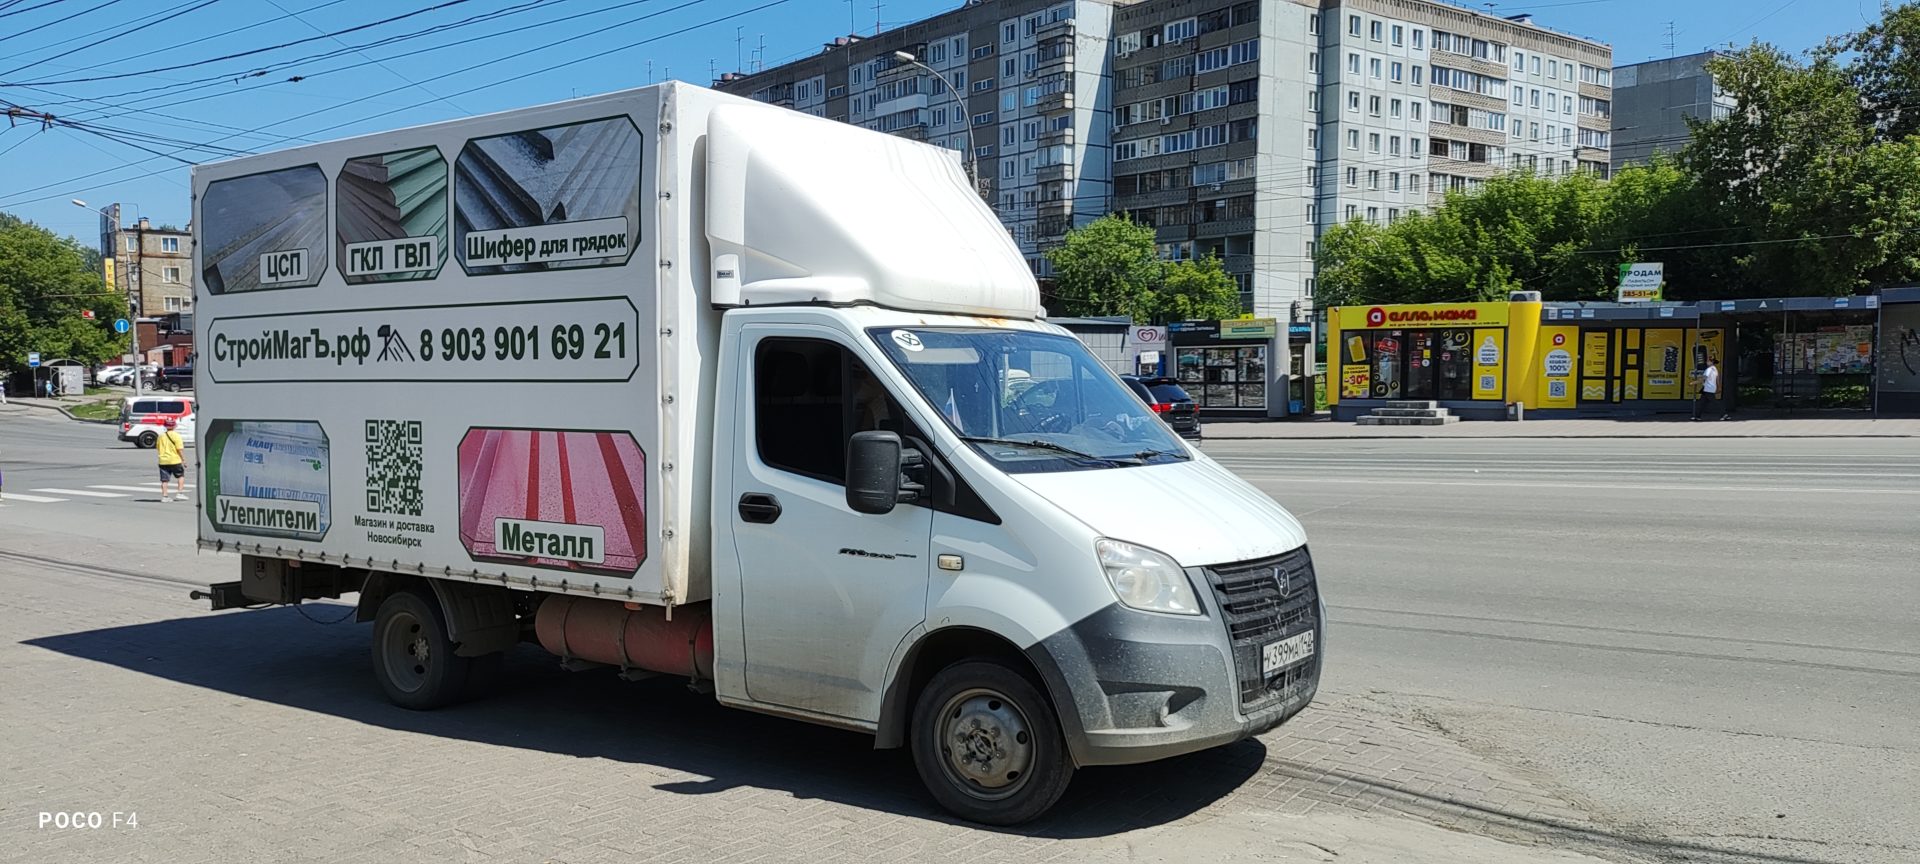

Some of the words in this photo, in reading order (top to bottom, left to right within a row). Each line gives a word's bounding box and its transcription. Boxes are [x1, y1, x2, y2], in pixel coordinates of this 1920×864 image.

[350, 246, 383, 272] ГКЛ
[395, 242, 430, 268] ГВЛ
[468, 234, 536, 263] Шифер
[540, 239, 568, 257] для
[573, 233, 626, 256] грядок
[267, 253, 301, 281] ЦСП
[1621, 270, 1661, 278] ПРОДАМ
[214, 326, 371, 368] СтройМагЪ.рф
[420, 328, 433, 361] 8
[441, 327, 486, 361] 903
[494, 325, 539, 361] 901
[551, 324, 584, 360] 69
[594, 322, 625, 359] 21
[220, 499, 317, 531] Утеплители
[354, 515, 387, 529] Магазин
[389, 521, 395, 529] и
[396, 521, 435, 534] доставка
[367, 531, 422, 549] Новосибирск
[502, 522, 593, 559] Металл
